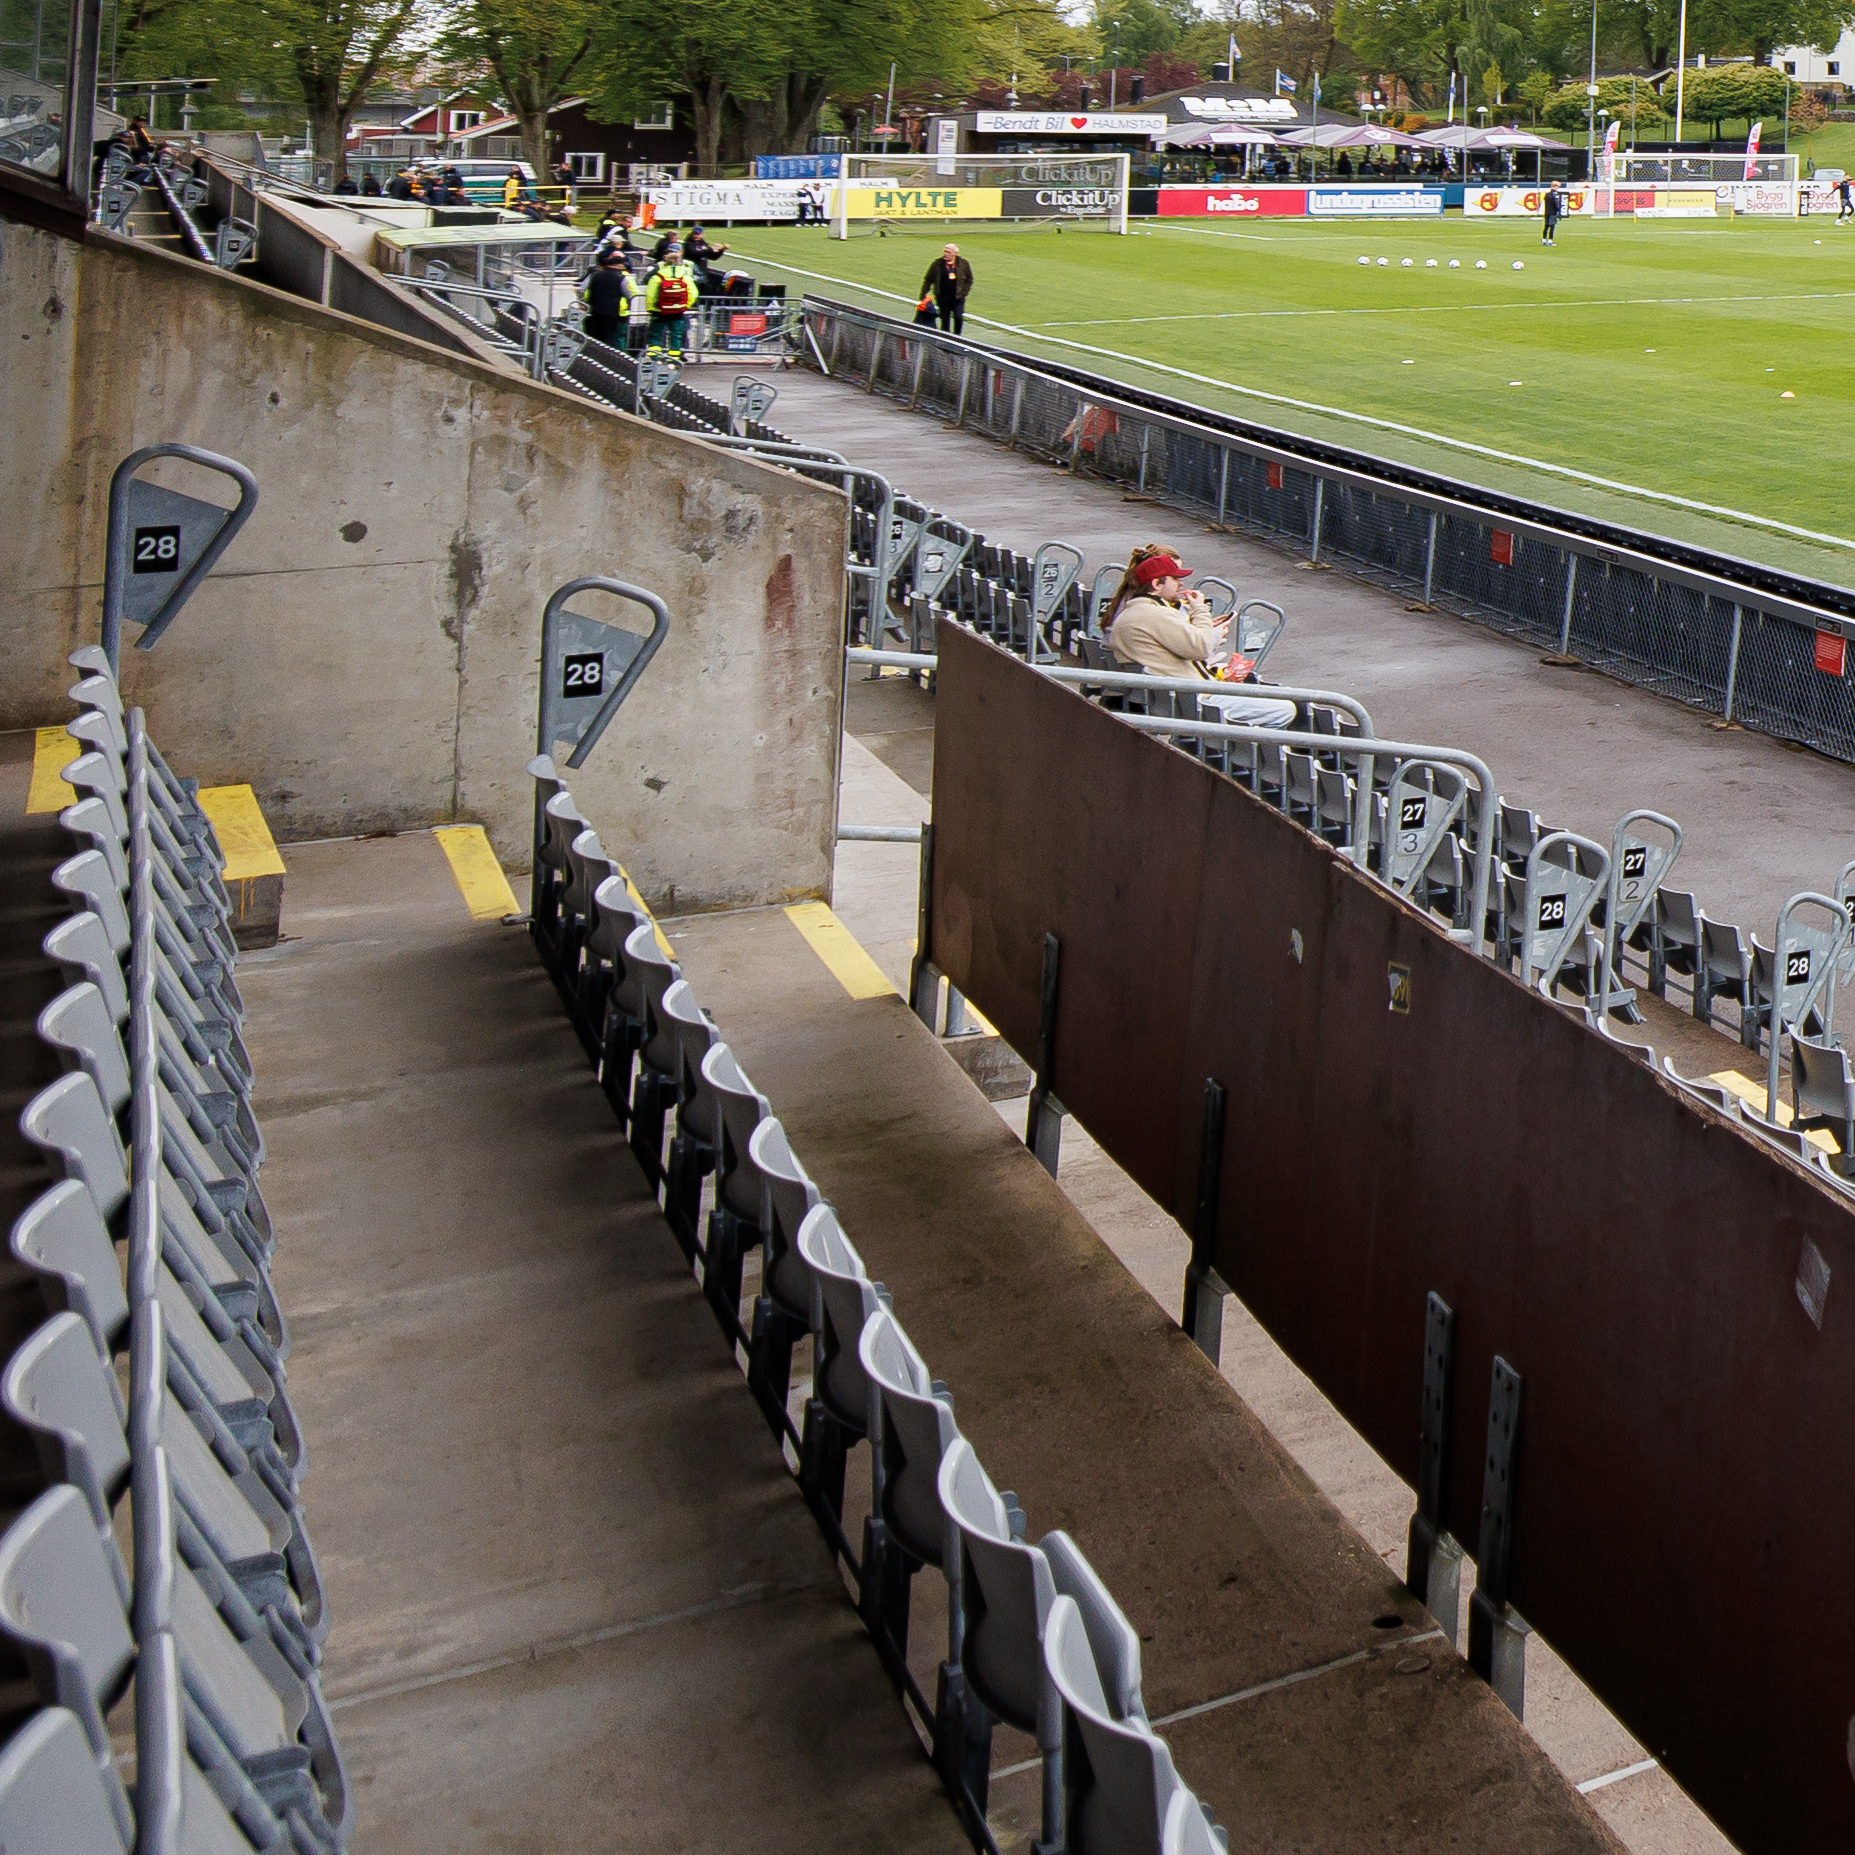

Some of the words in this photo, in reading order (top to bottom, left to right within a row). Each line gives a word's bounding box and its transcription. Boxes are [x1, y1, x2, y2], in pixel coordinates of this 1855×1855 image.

[993, 116, 1040, 130] Bendt
[1045, 116, 1065, 130] Bil
[1092, 119, 1163, 130] HALMSTAD
[655, 191, 744, 205] STIGMA
[875, 192, 958, 208] HYLTE
[1035, 190, 1121, 207] ClickitUp
[1746, 199, 1788, 210] Sjögren
[1756, 191, 1783, 202] Bygg
[137, 536, 177, 562] 28
[1043, 584, 1054, 596] 2
[566, 662, 601, 685] 28
[1402, 804, 1425, 822] 27
[1401, 833, 1418, 853] 3
[1624, 853, 1645, 870] 27
[1625, 881, 1639, 899] 2
[1541, 902, 1564, 921] 28
[1788, 958, 1809, 976] 28
